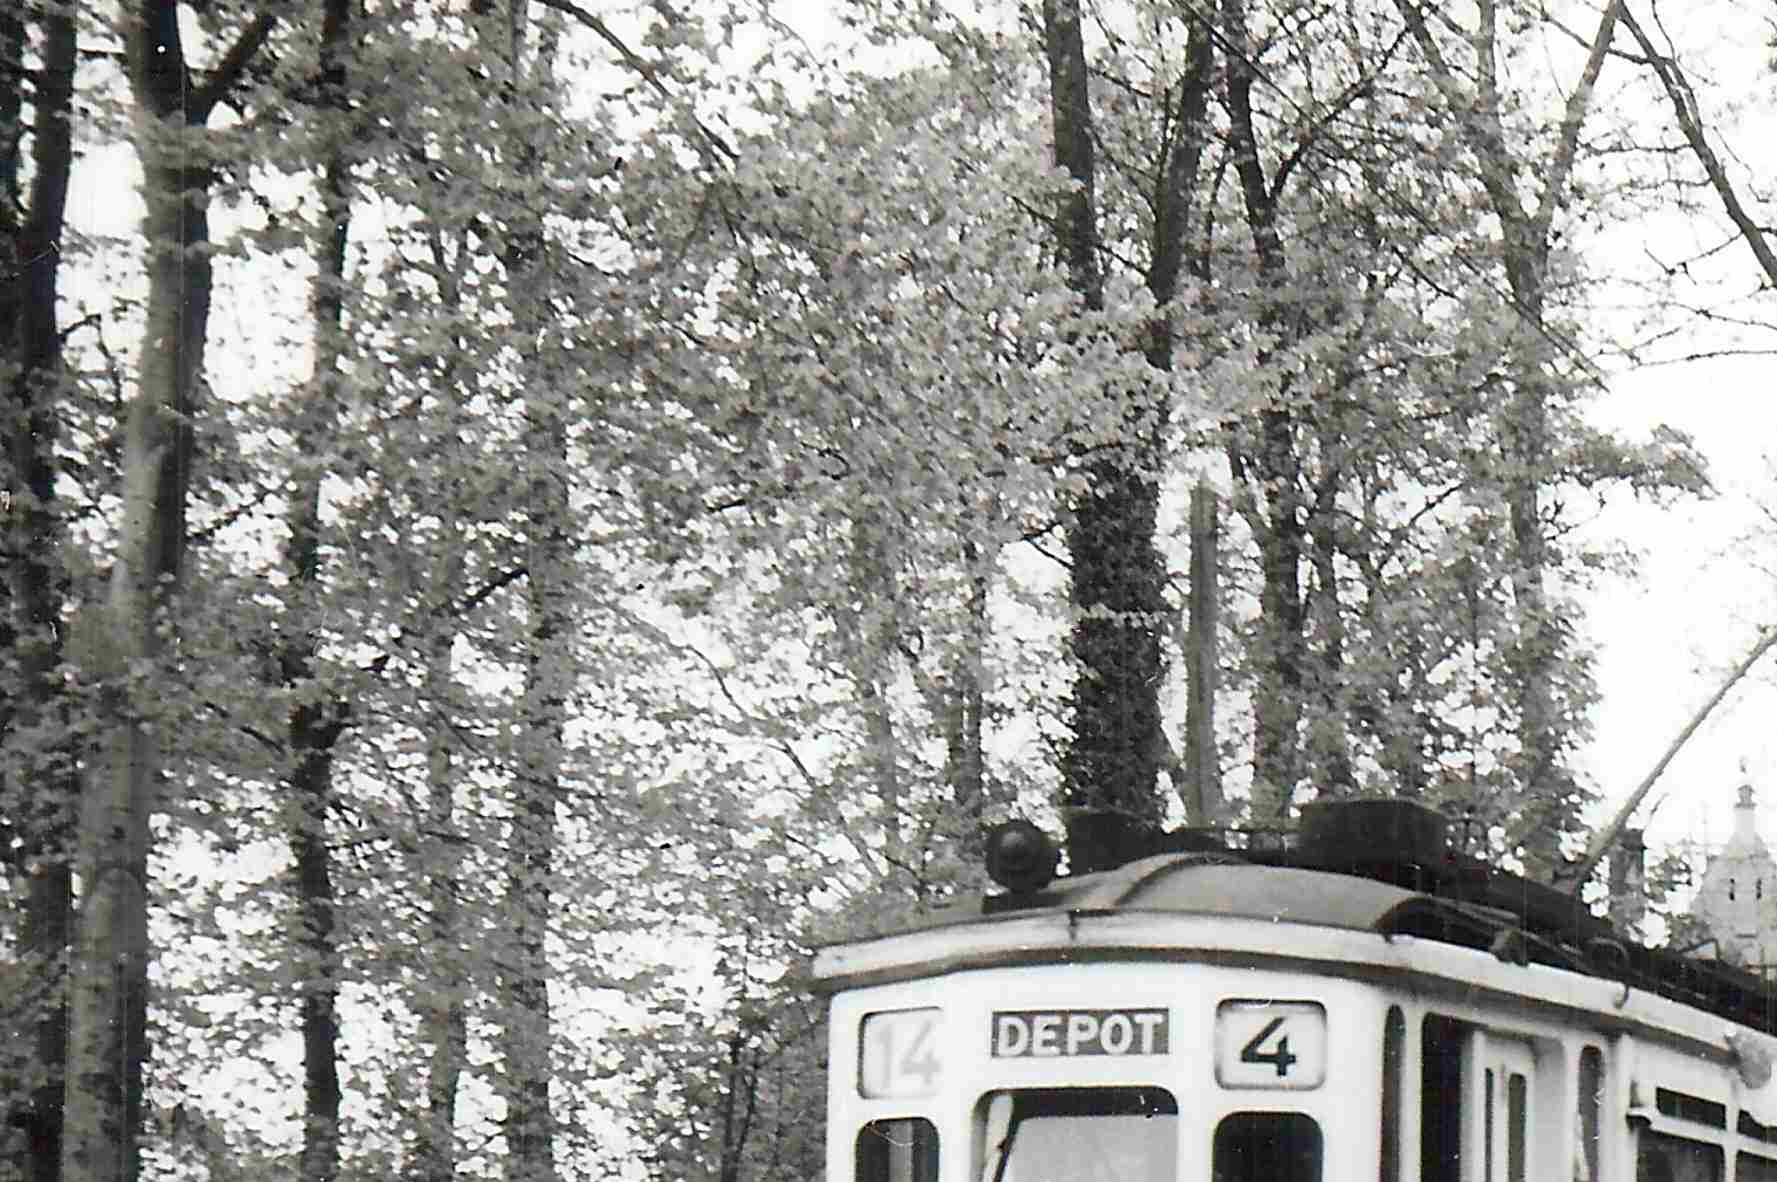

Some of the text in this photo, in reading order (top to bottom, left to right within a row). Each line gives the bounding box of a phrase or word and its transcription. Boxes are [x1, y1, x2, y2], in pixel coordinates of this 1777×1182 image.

[874, 1020, 941, 1087] 14
[997, 1013, 1164, 1057] DEPOT
[1239, 1016, 1297, 1078] 4
